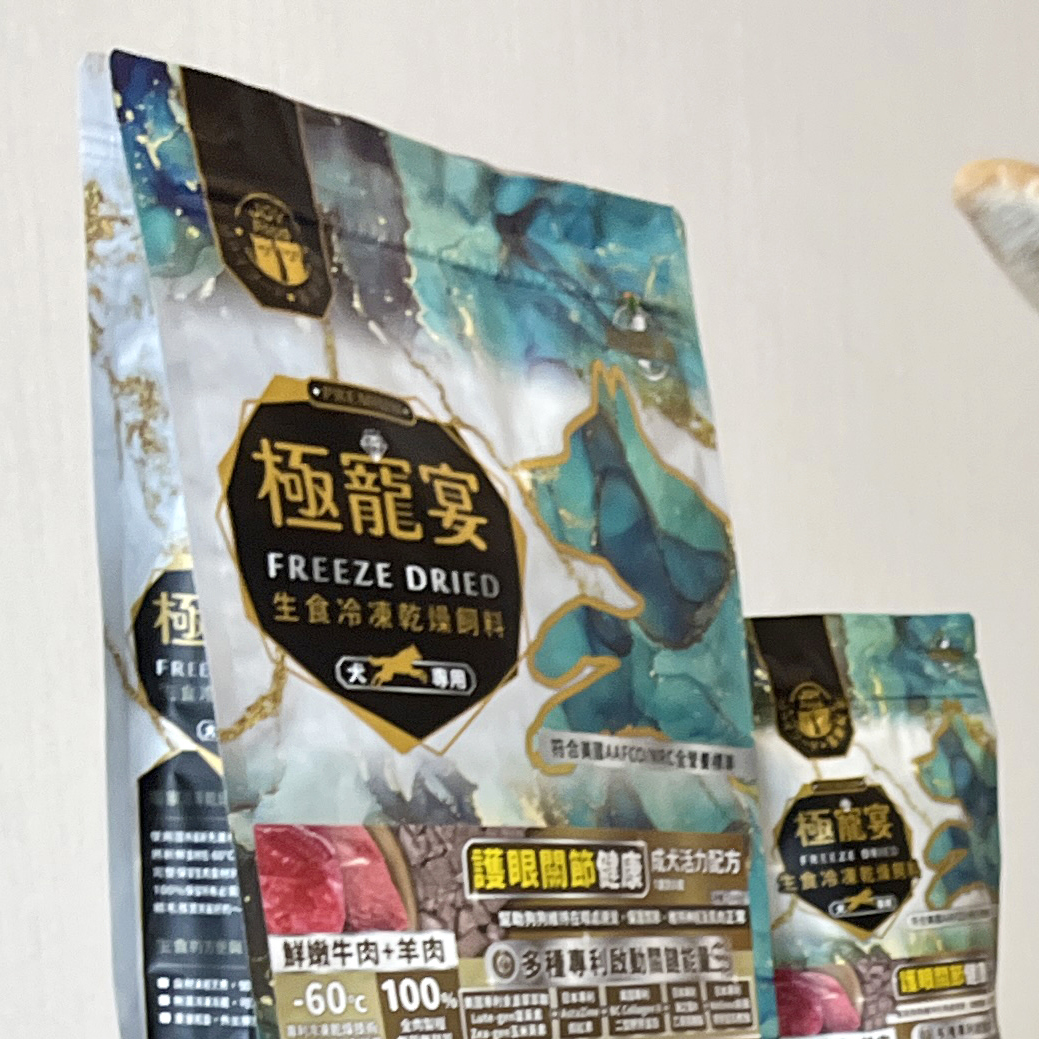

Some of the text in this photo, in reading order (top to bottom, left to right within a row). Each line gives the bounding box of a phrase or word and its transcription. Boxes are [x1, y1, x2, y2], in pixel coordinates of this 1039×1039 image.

[252, 437, 489, 552] 極寵宴
[266, 552, 500, 599] FREEZE DRIED
[273, 592, 504, 639] 生食冷凍乾燥飼料
[794, 803, 894, 848] 極寵宴
[471, 846, 644, 890] 護眼關節健康
[282, 936, 446, 968] 鮮嫩牛肉+羊肉
[381, 975, 459, 1014] 100%
